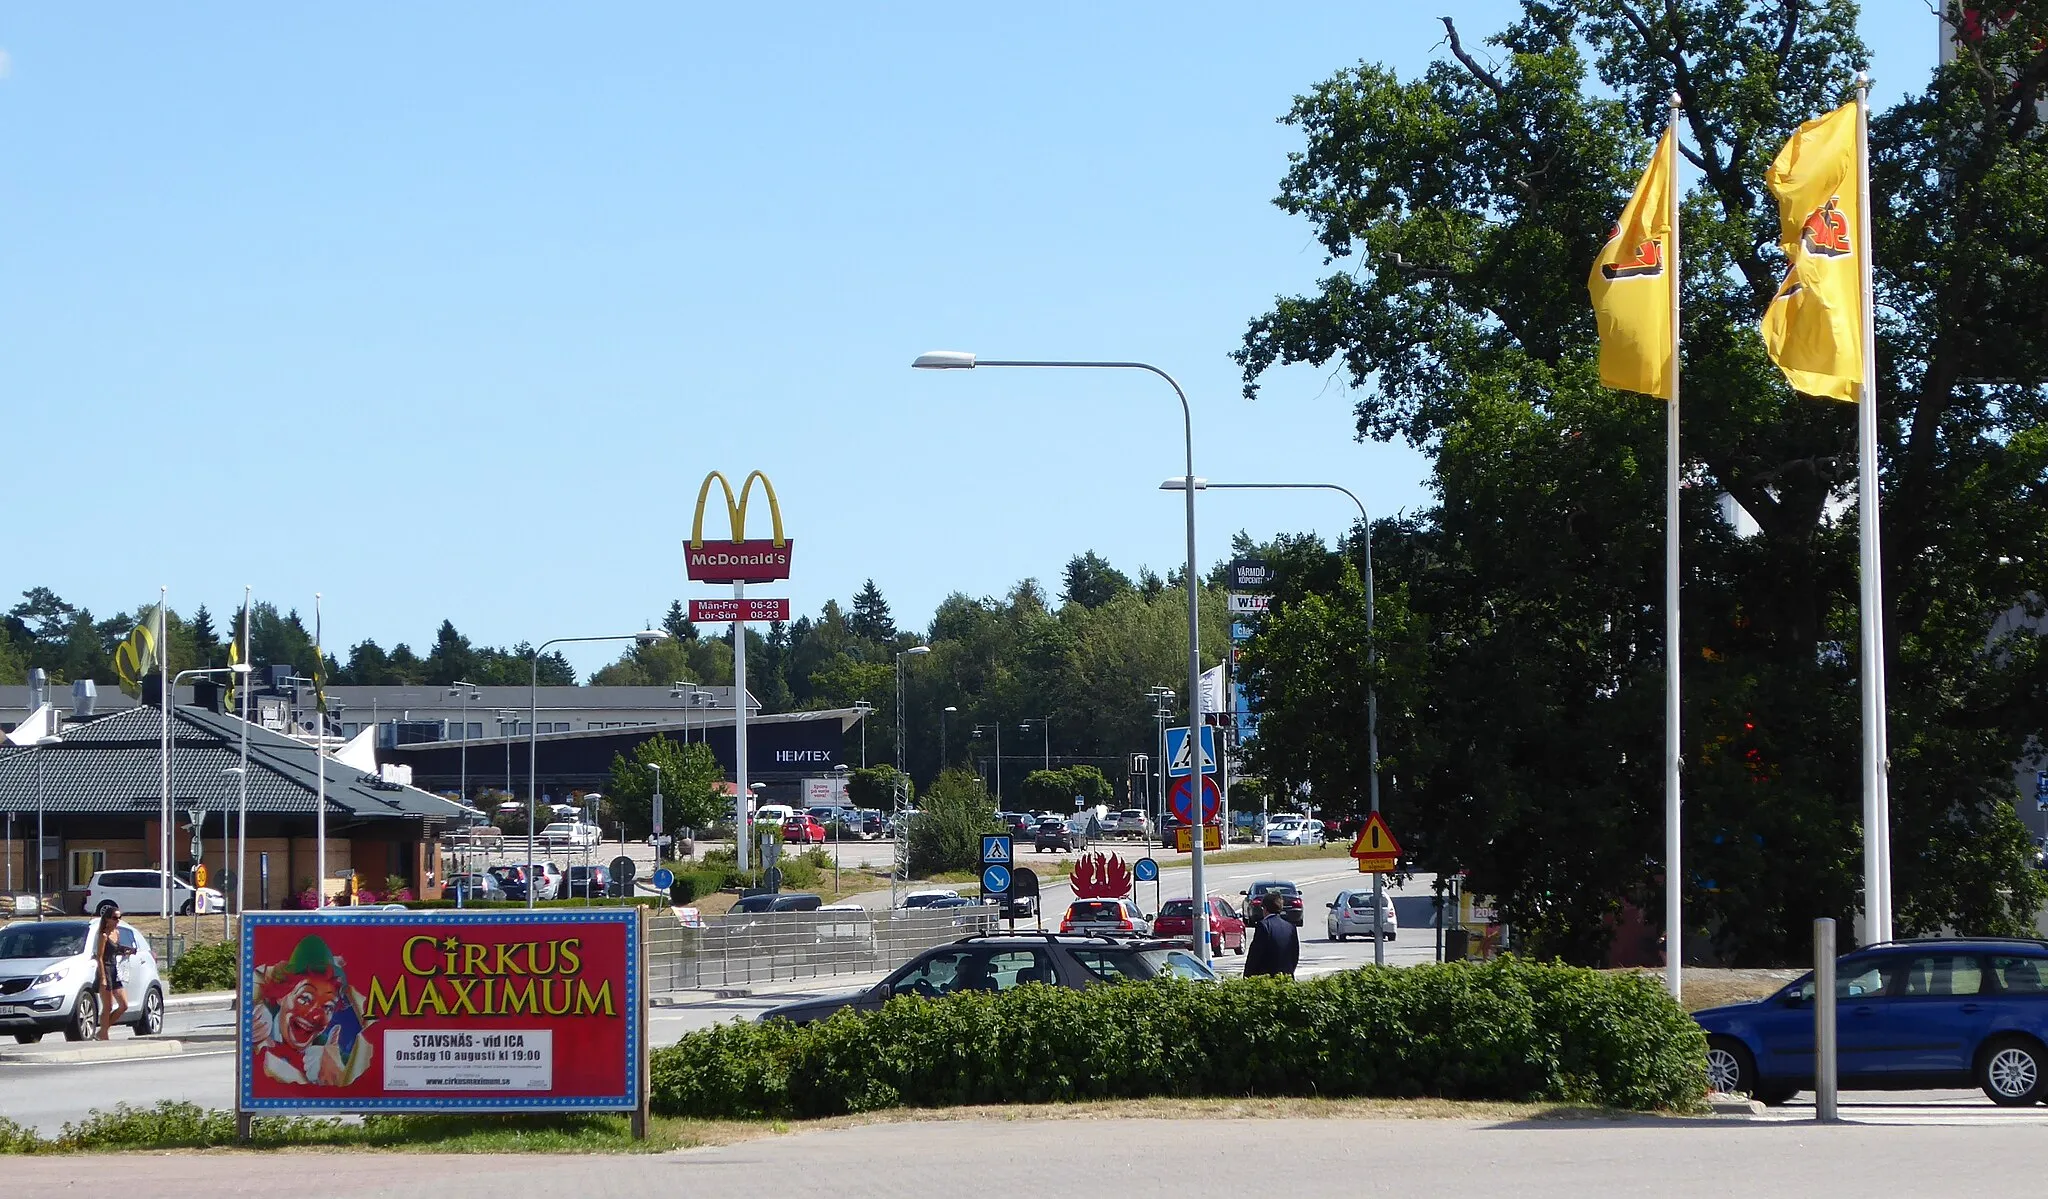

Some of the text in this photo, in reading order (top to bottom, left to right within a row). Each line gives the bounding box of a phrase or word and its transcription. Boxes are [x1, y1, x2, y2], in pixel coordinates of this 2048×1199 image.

[691, 553, 786, 566] McDonald's
[1237, 566, 1266, 577] VÄRMDÖ
[698, 600, 779, 610] Mån-Fre 06-23
[698, 610, 779, 619] Lör-Sön 08-23
[776, 750, 831, 762] HEMTEX
[363, 974, 617, 1019] MAXIMUM
[413, 1032, 473, 1048] STAVSNÄS
[483, 1034, 501, 1048] vid
[504, 1034, 524, 1048] ICA
[396, 1050, 541, 1062] Onsdag 10 augusti kl 19:00
[425, 1077, 511, 1086] www.cirkusmaximum.se
